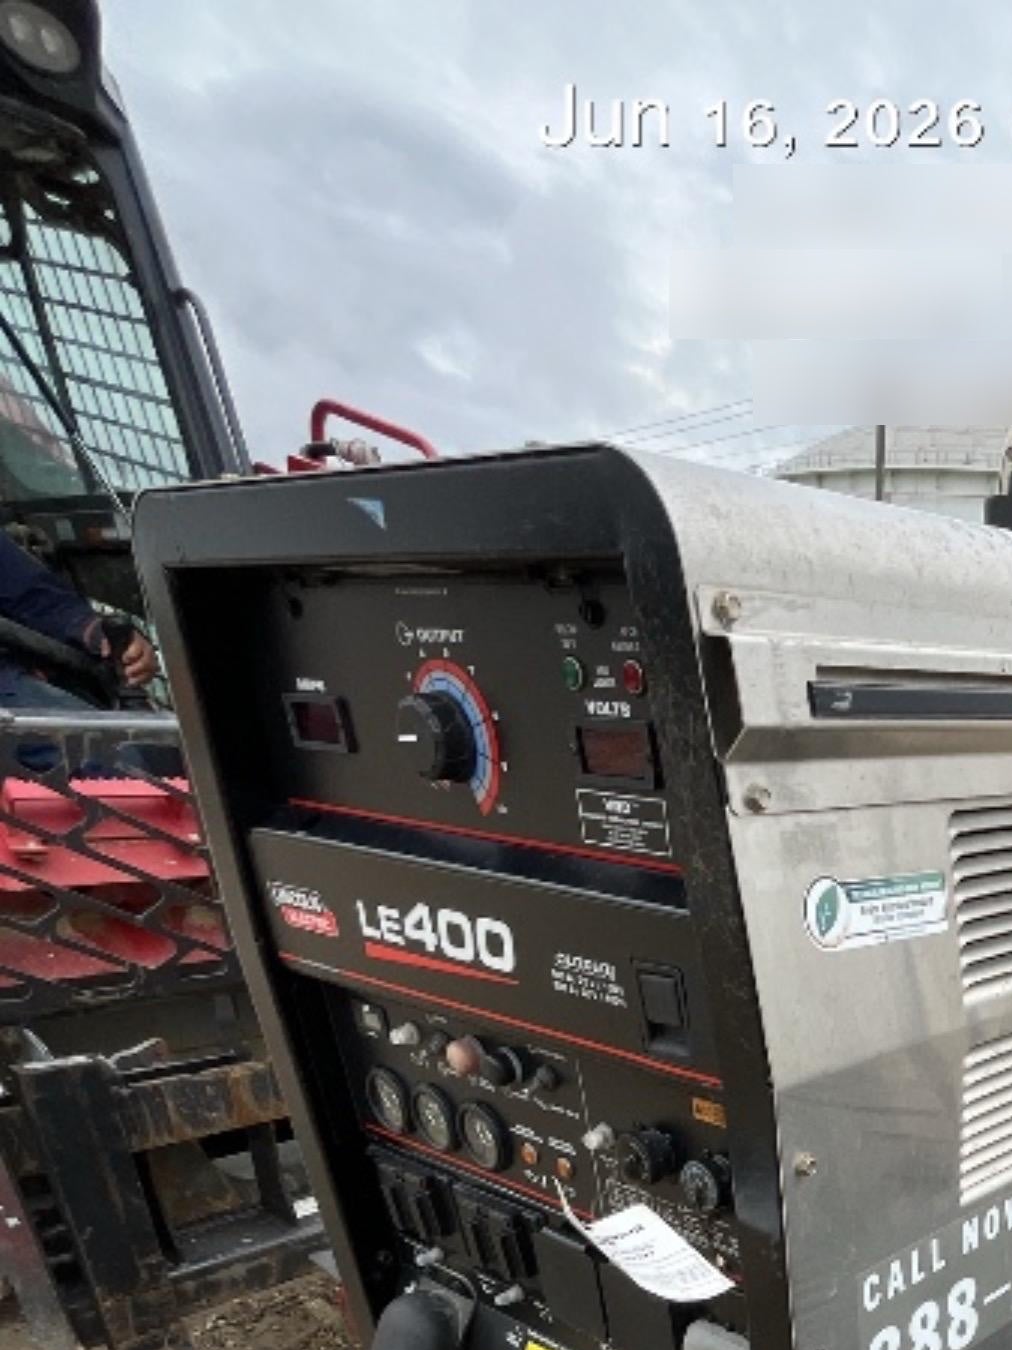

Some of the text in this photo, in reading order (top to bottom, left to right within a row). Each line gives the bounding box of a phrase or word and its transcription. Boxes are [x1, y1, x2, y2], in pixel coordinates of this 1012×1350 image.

[584, 698, 631, 718] VOLTS
[356, 899, 515, 973] LE400
[863, 1238, 946, 1312] CALL
